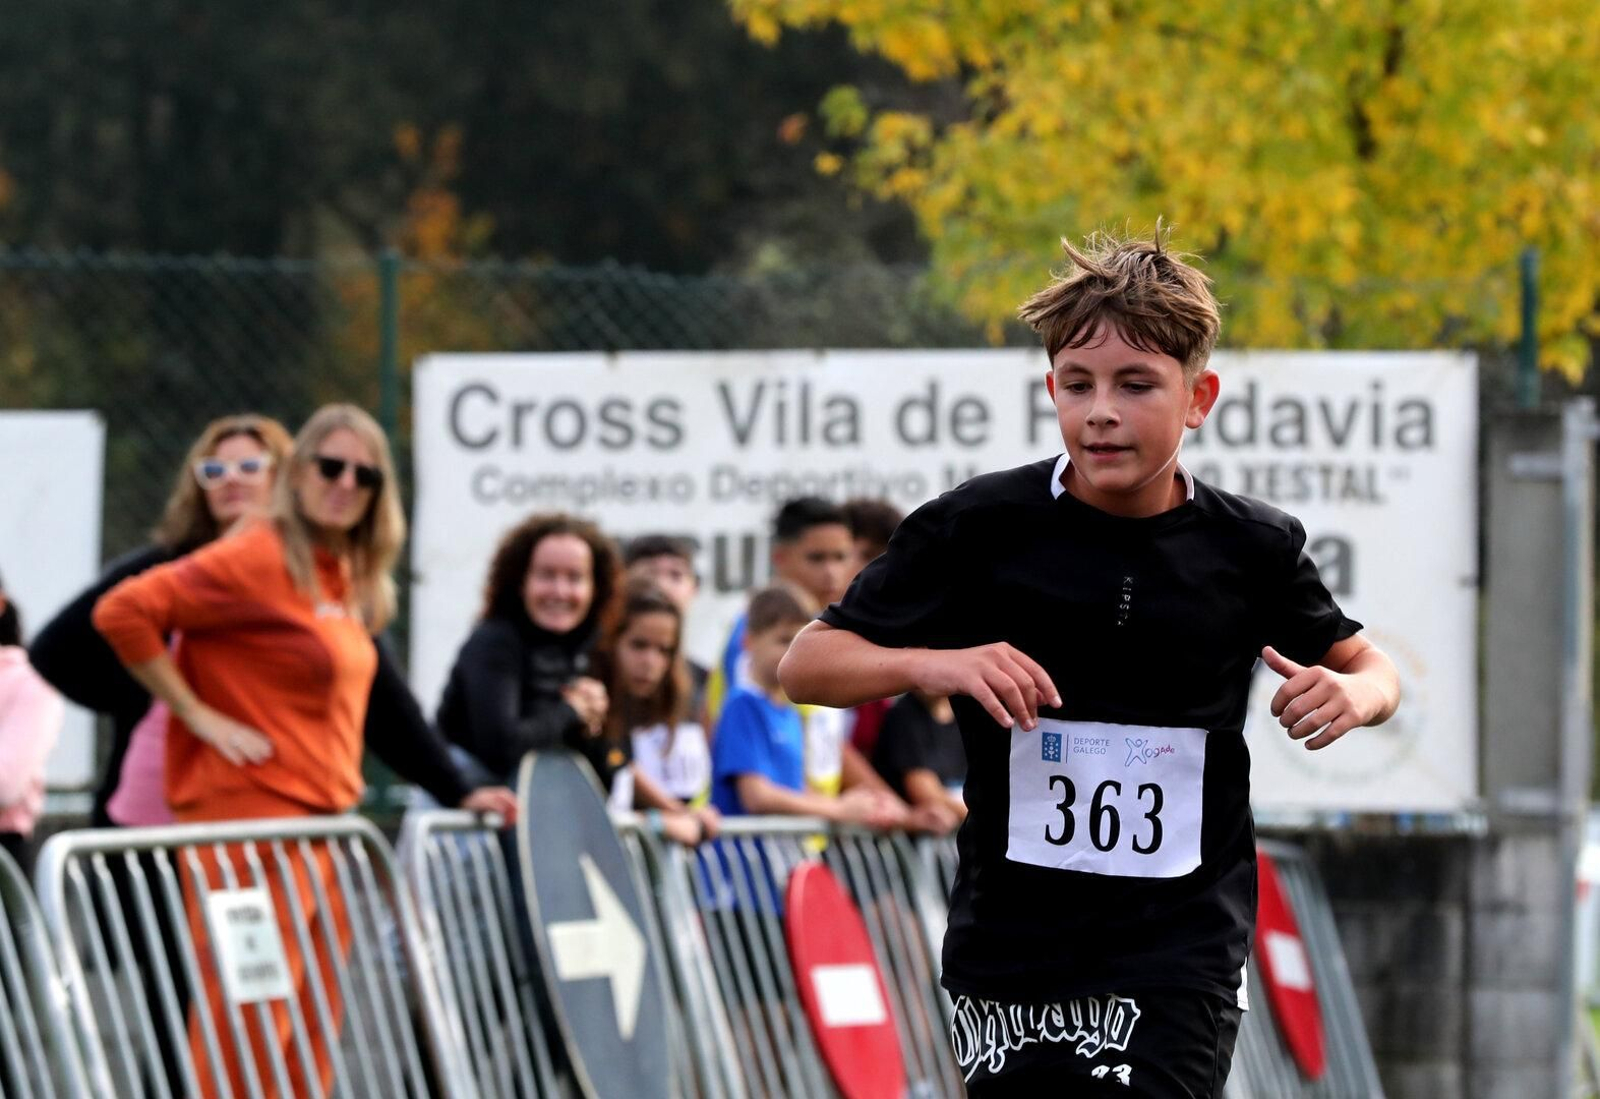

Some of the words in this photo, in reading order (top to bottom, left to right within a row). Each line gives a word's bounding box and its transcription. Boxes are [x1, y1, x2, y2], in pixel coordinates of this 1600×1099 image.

[448, 381, 685, 450] Cross
[716, 379, 863, 449] Vila
[894, 379, 990, 449] de
[1025, 377, 1435, 450] davia
[470, 463, 696, 507] Complexo
[1073, 737, 1111, 747] DEPORTE
[1073, 745, 1107, 756] GALEGO
[1044, 774, 1165, 855] 363
